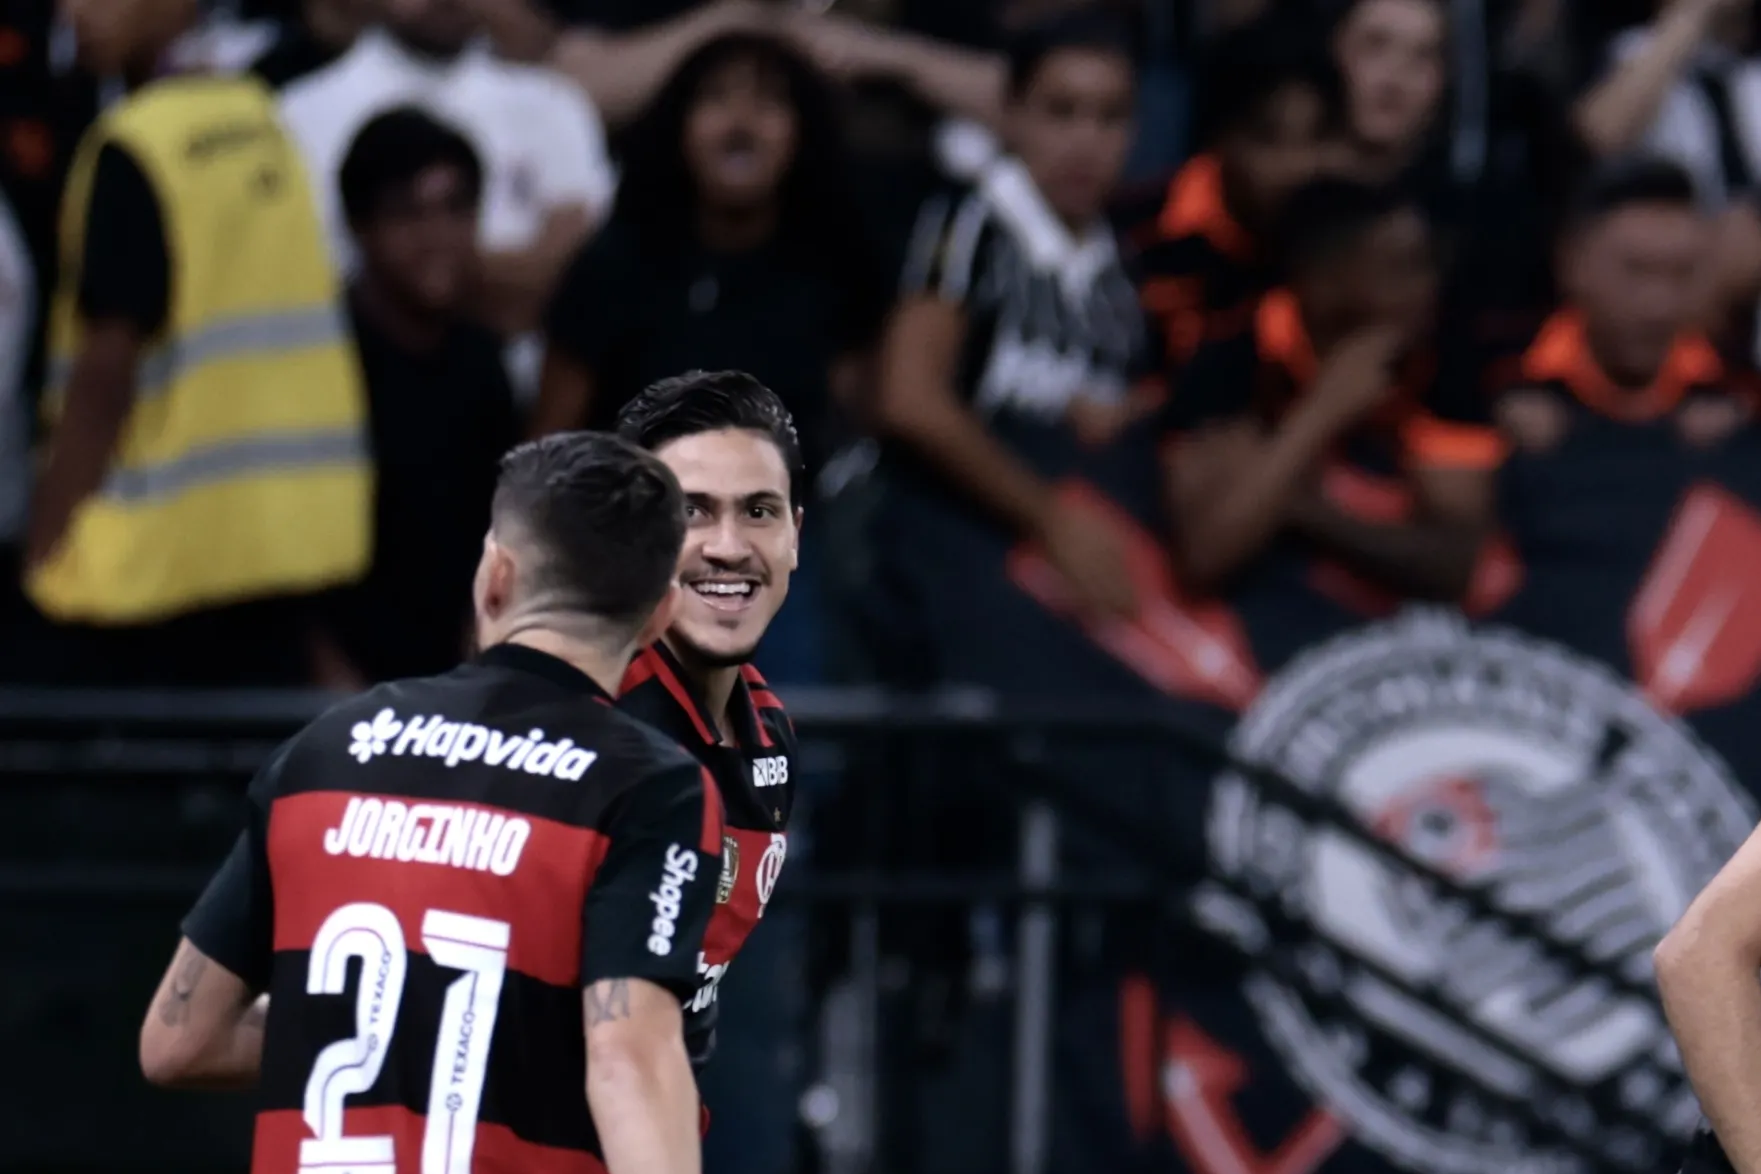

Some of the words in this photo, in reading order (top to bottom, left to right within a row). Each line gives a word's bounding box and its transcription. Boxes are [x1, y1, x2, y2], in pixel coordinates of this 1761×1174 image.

[391, 712, 598, 781] Hapvida
[323, 796, 531, 877] JORGINHO
[647, 842, 699, 956] Shopee
[449, 1010, 477, 1086] TEXACO
